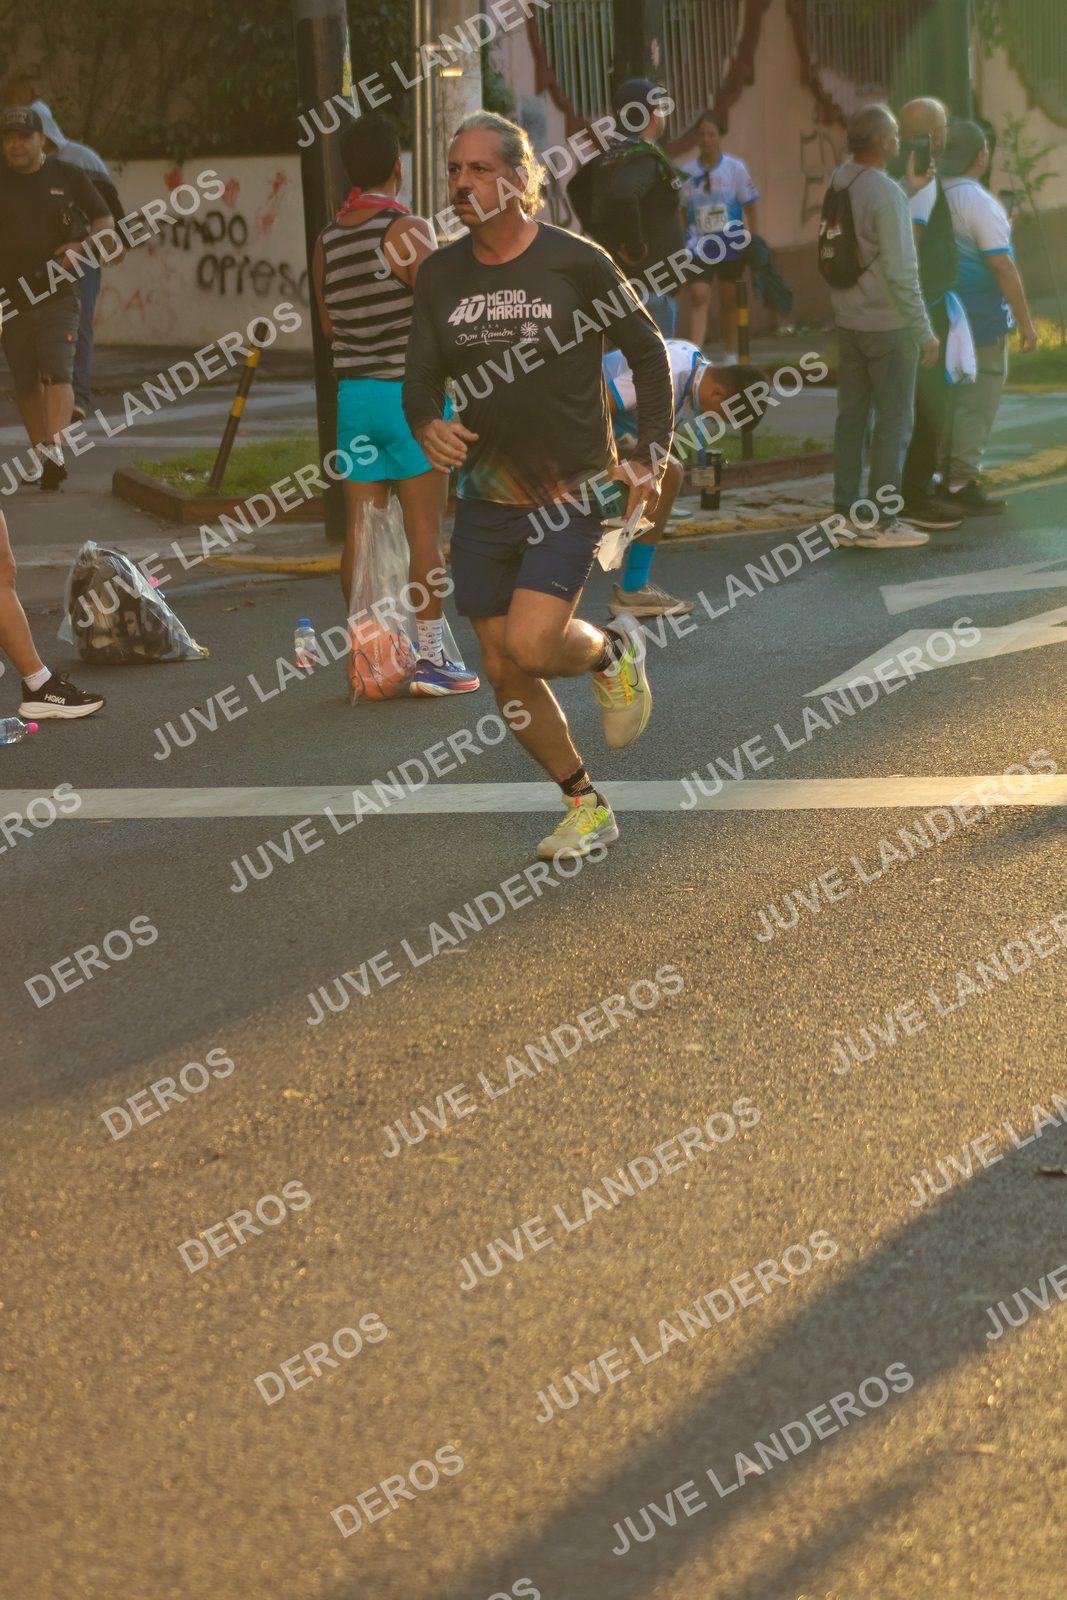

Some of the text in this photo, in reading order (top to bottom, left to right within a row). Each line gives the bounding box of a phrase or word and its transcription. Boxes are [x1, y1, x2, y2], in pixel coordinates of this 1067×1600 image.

[487, 289, 527, 307] MEDIO
[447, 294, 486, 326] 40
[487, 298, 552, 321] MARATÓN
[455, 333, 478, 345] Don
[44, 693, 66, 705] HOKA
